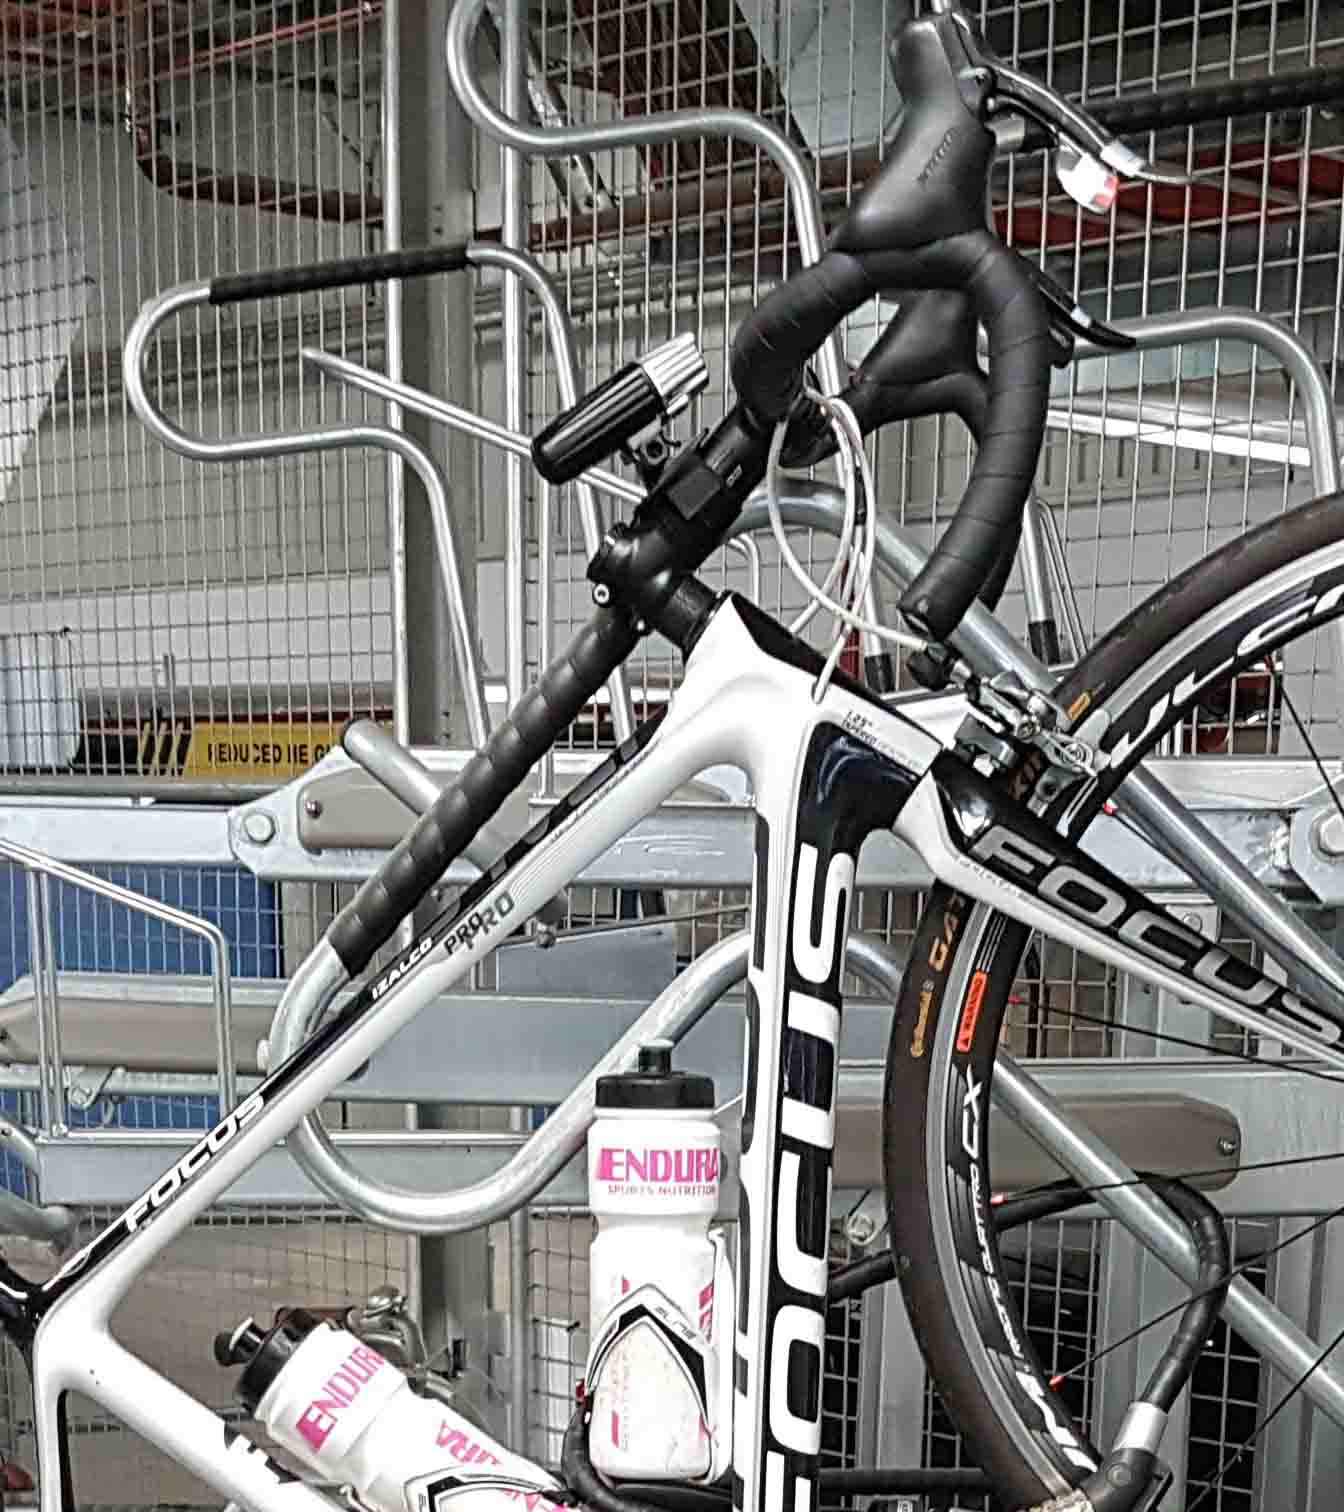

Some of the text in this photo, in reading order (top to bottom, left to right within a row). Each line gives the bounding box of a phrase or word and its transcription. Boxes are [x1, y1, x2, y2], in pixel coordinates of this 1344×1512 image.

[370, 936, 433, 1000] IZALCO
[969, 824, 1343, 1045] FOCUS
[125, 1095, 265, 1233] FOCUS
[961, 1064, 983, 1160] CX
